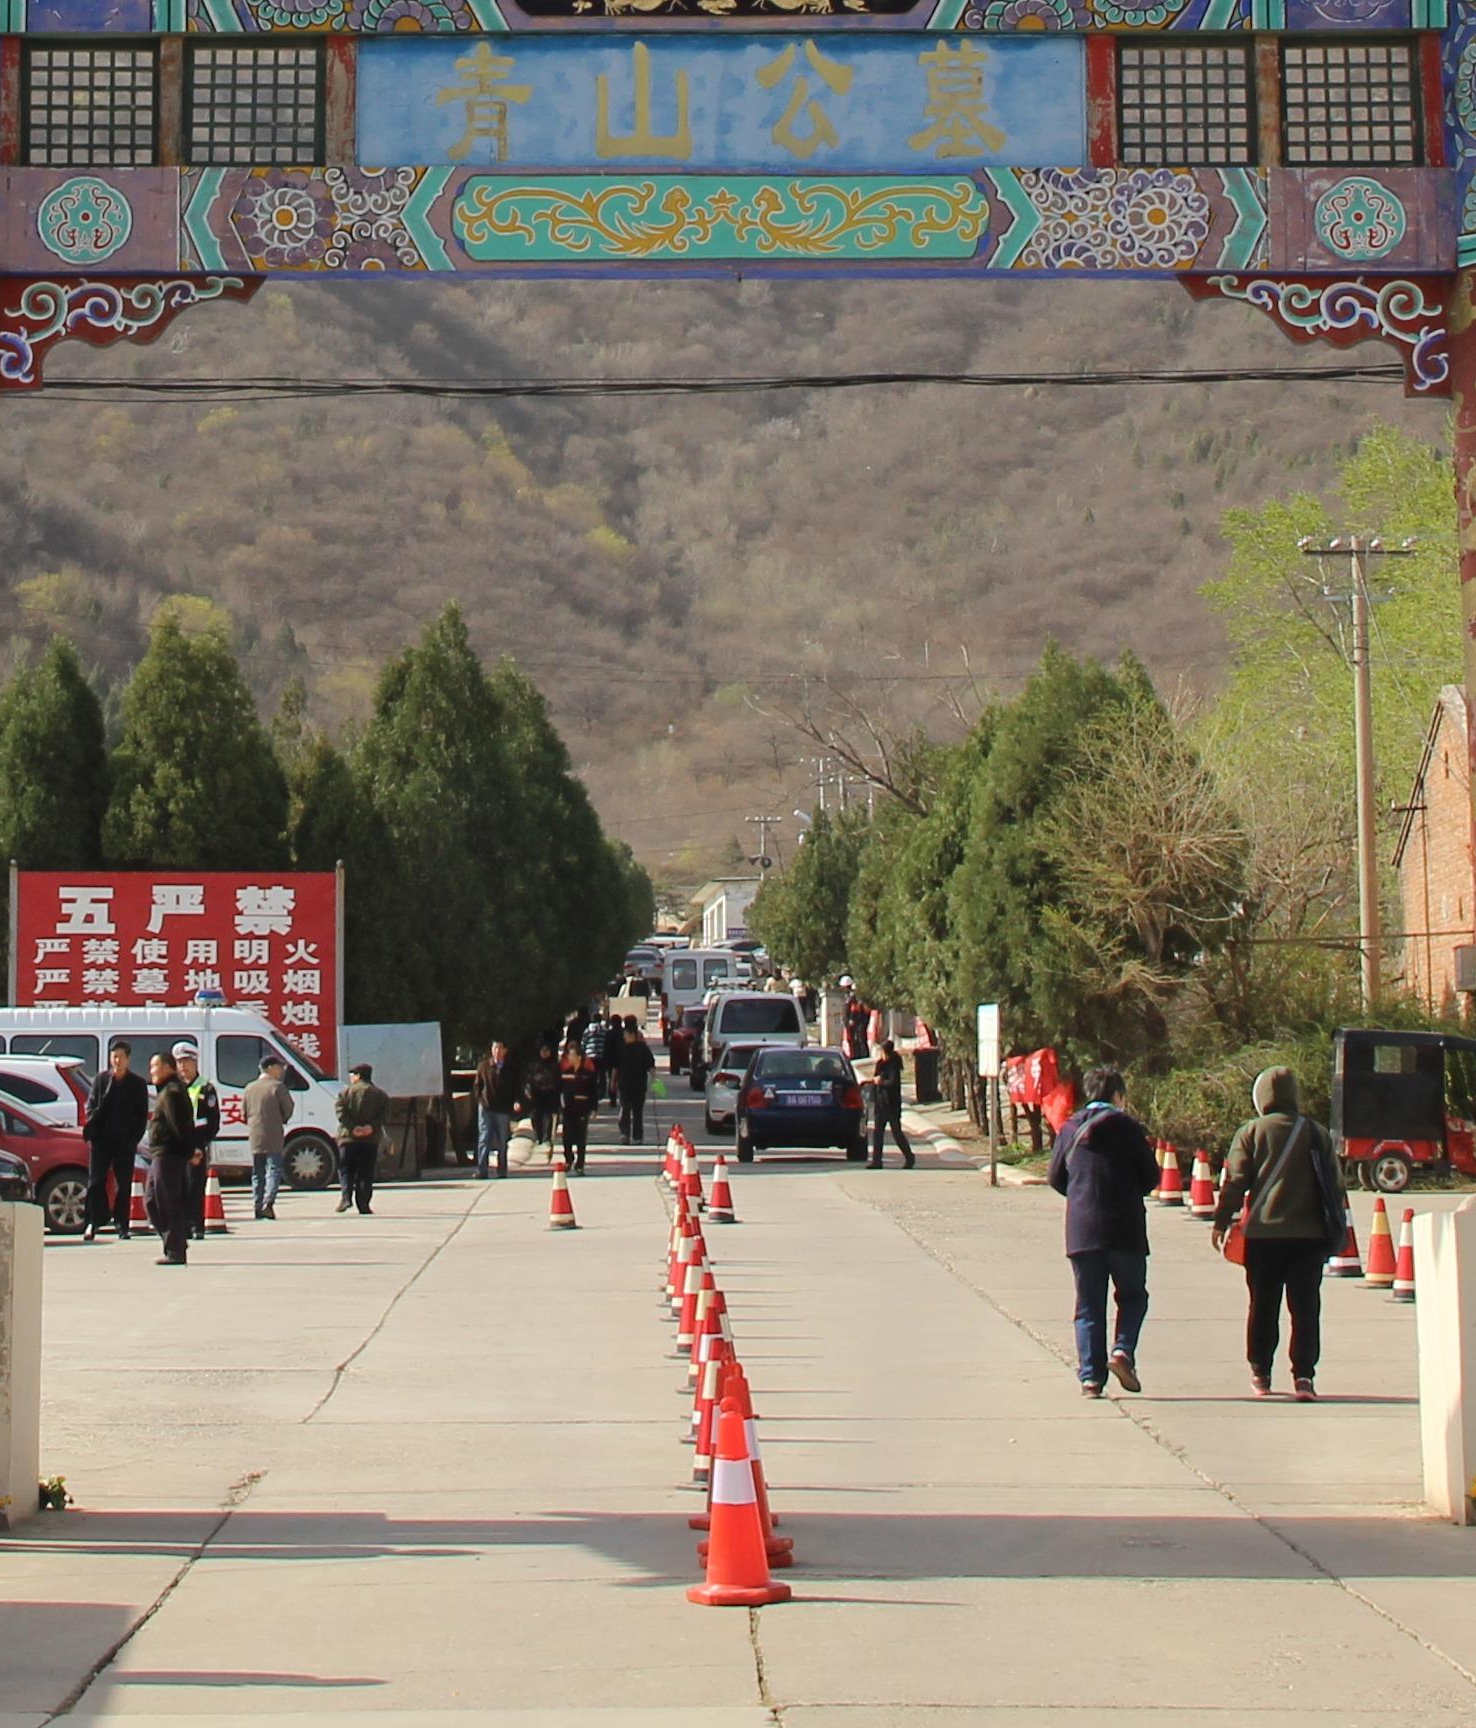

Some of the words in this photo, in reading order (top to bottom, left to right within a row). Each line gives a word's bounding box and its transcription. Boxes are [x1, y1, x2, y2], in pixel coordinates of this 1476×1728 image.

[435, 38, 1006, 163] 青山公墓
[56, 884, 296, 935] 五严禁
[33, 938, 321, 965] 严禁使用明火
[33, 968, 321, 995] 严禁墓地吸烟
